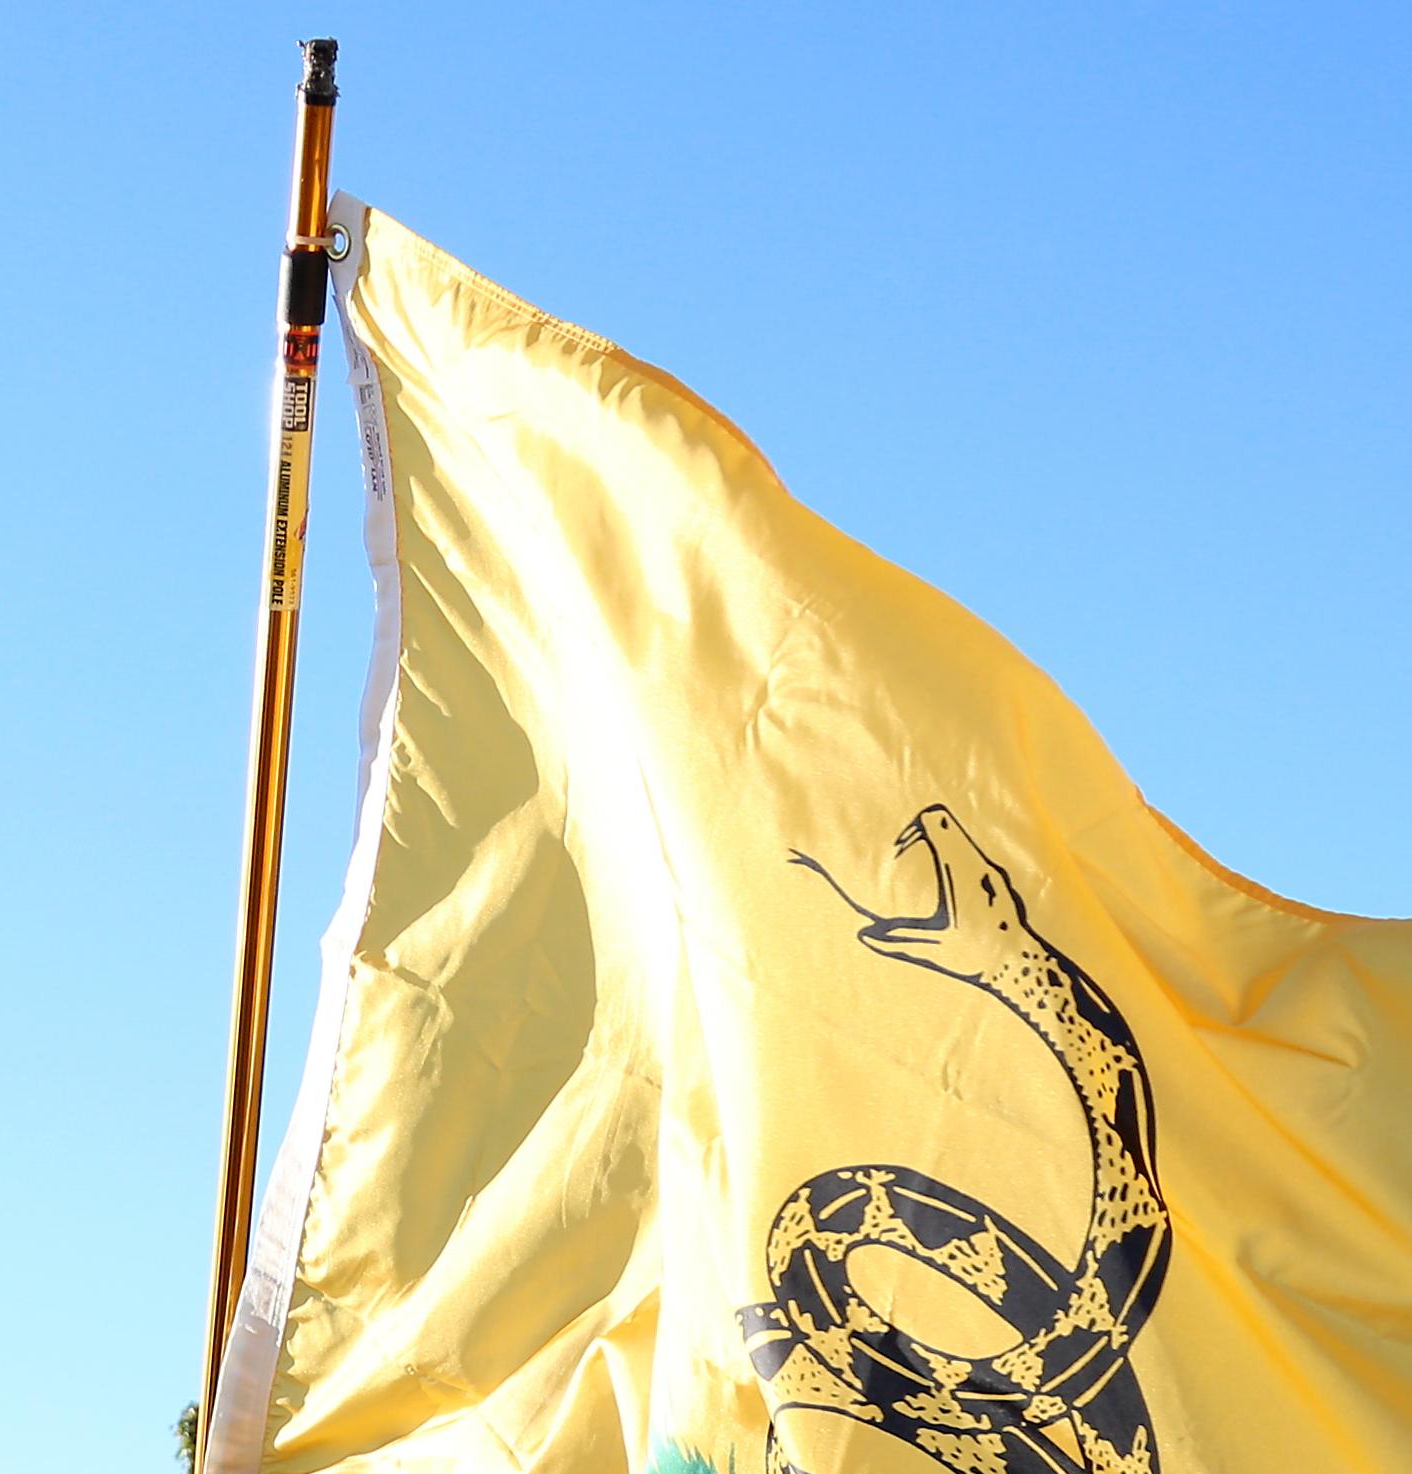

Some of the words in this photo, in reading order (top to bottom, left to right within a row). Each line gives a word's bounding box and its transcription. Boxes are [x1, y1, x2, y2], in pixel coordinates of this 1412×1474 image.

[283, 382, 296, 428] SHOP
[294, 382, 308, 426] TOOL
[278, 460, 292, 516] ALUMINUM
[274, 519, 289, 576] EXTENSION
[272, 579, 285, 605] POLE
